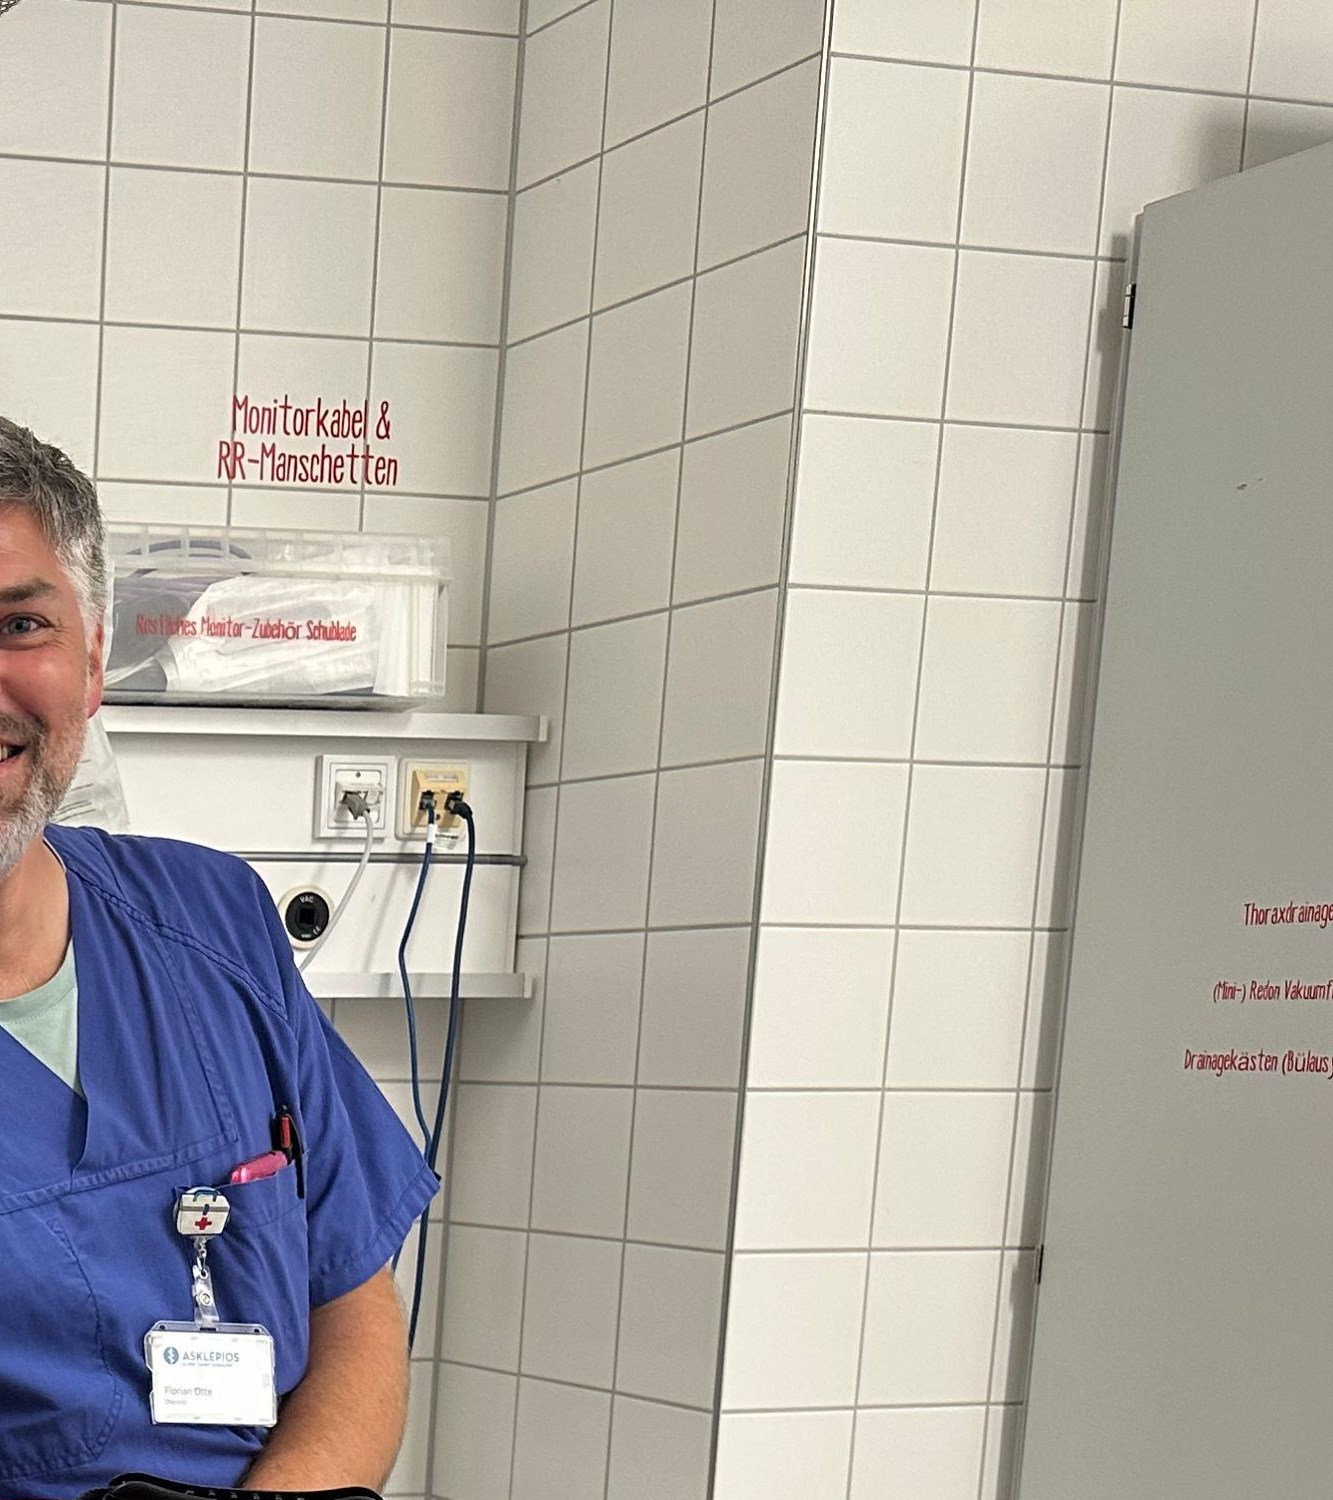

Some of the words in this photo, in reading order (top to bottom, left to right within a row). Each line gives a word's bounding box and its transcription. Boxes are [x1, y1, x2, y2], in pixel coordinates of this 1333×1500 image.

[232, 394, 368, 440] Monitorkabel
[376, 401, 391, 440] &
[217, 440, 399, 486] RR-Manschetten
[201, 616, 302, 640] Monitor-Zubehör
[306, 619, 357, 641] Schublade
[1244, 901, 1333, 929] Thoraxdrainage
[1249, 980, 1281, 1001] Redon
[1284, 979, 1333, 1001] Vakuumf
[1184, 1048, 1279, 1077] Drainagekästen
[182, 1351, 240, 1363] ASKLEPIOS
